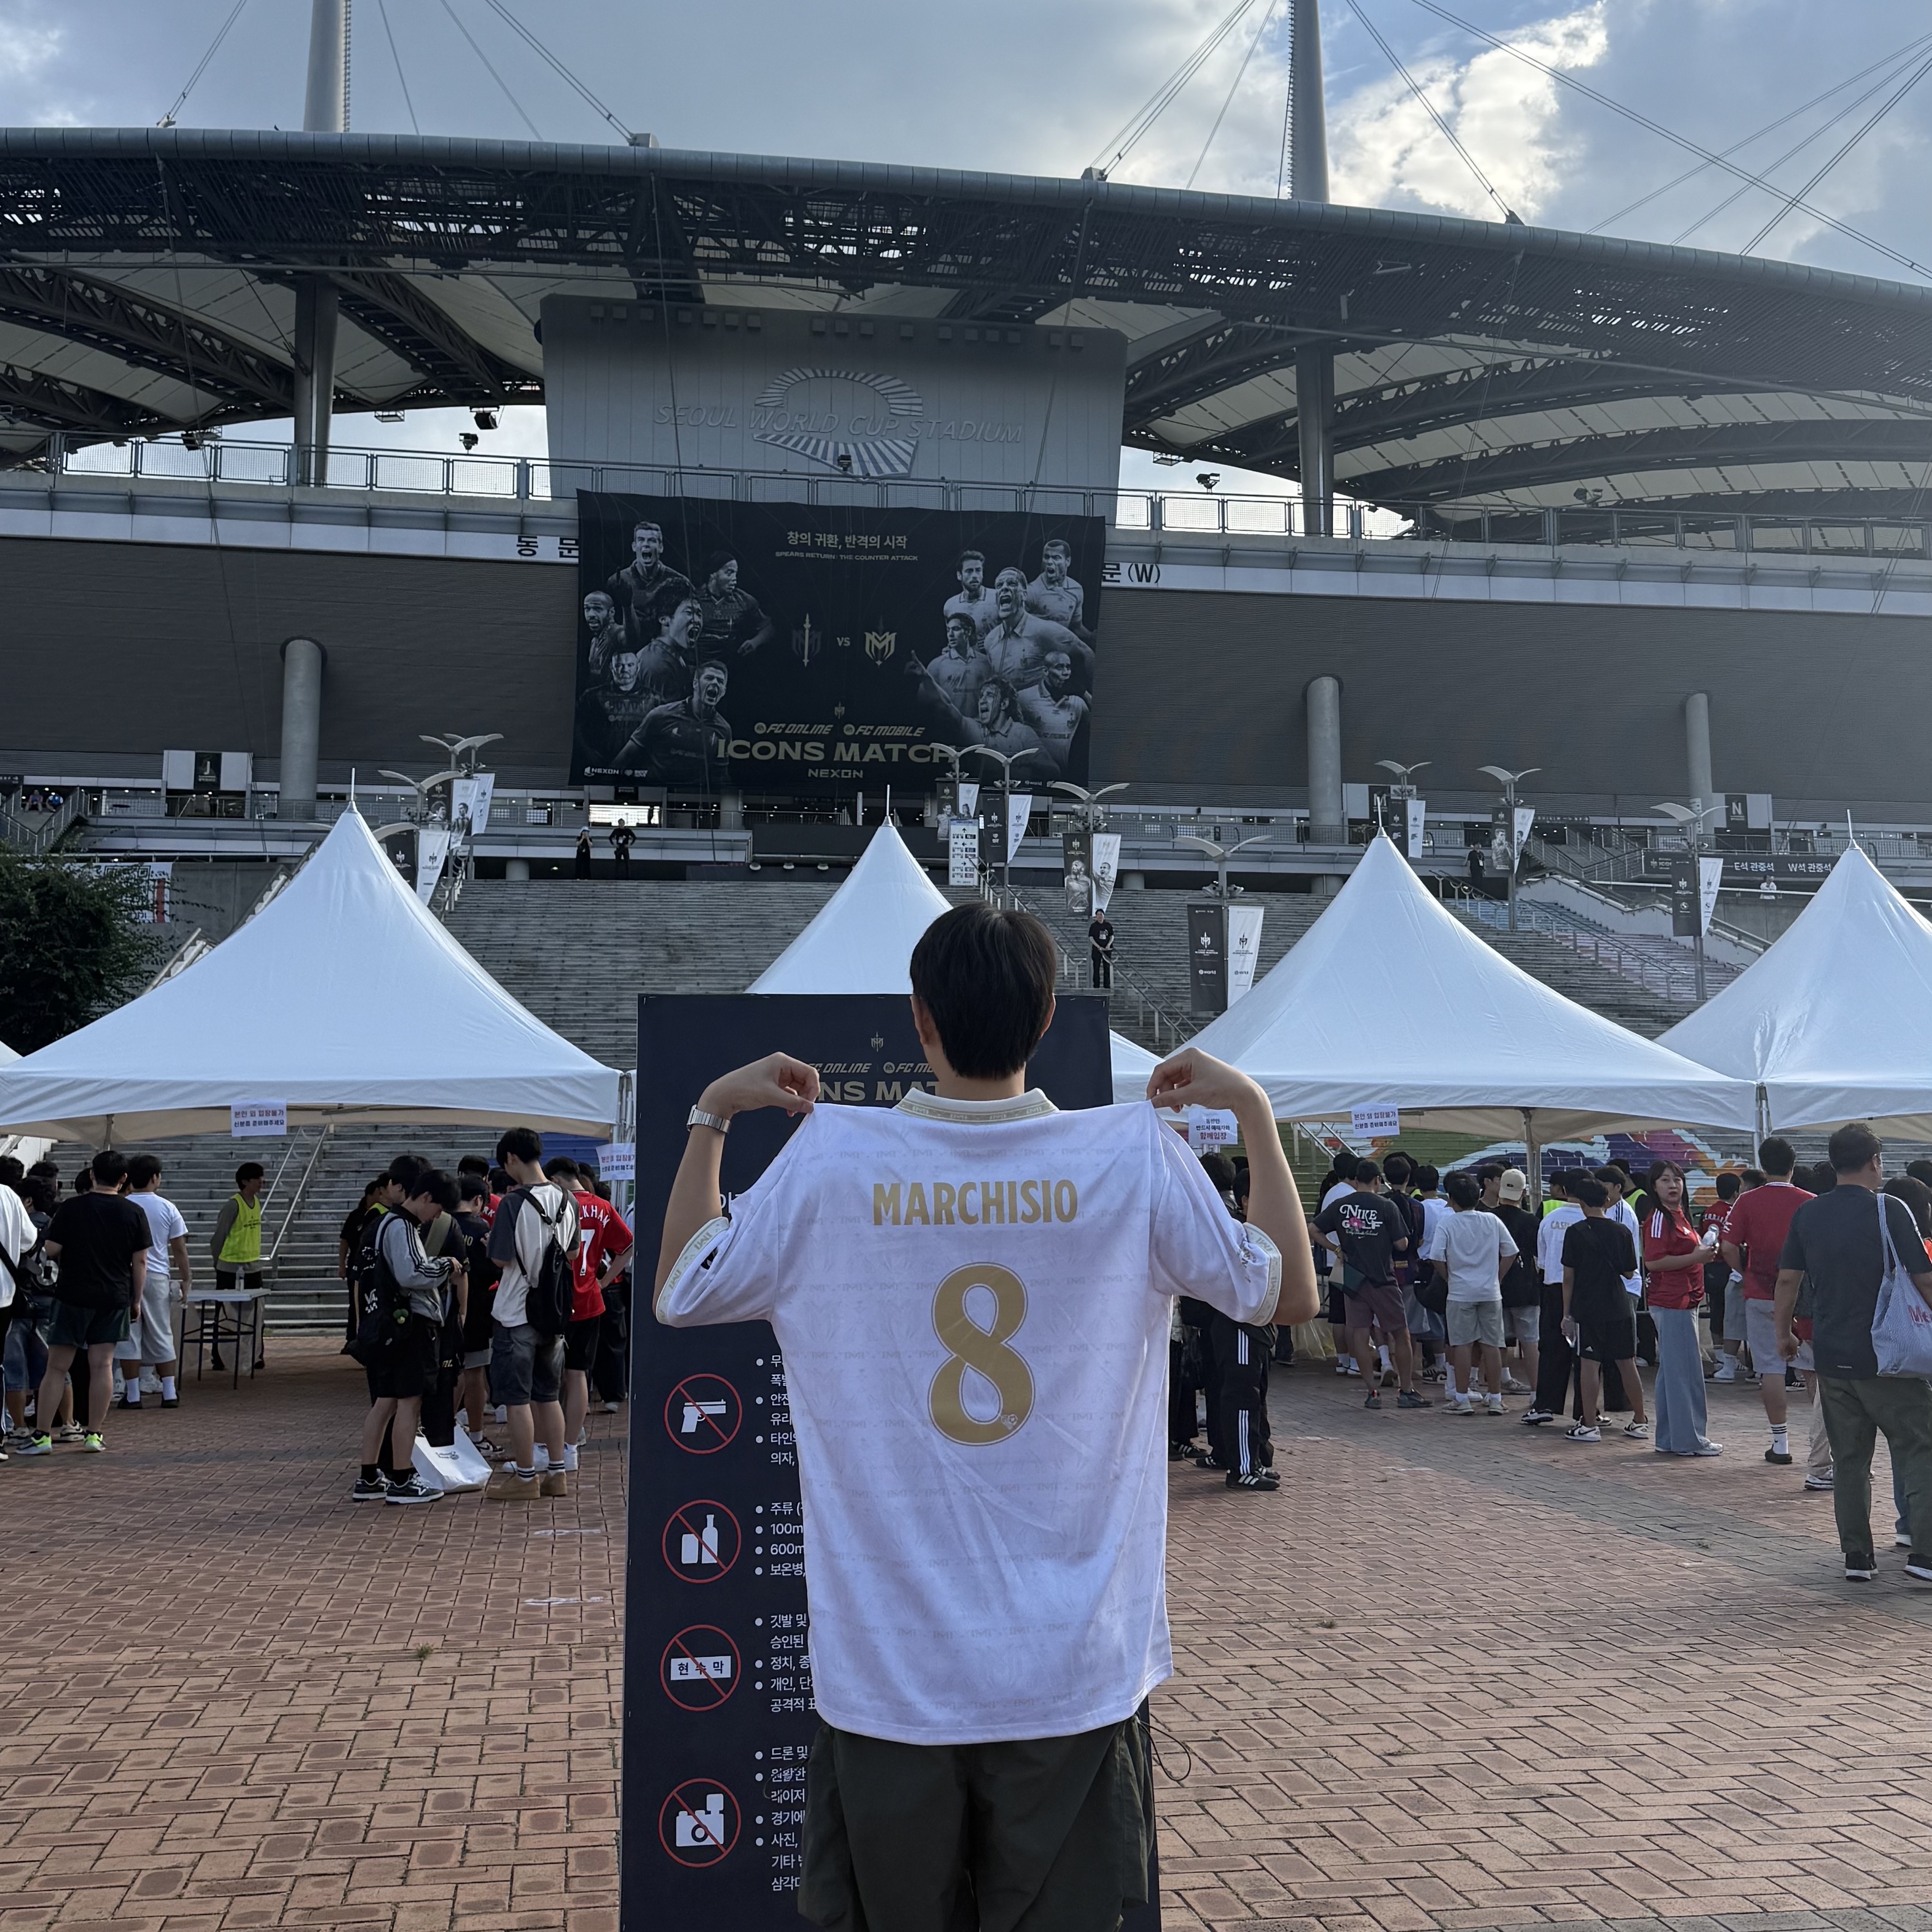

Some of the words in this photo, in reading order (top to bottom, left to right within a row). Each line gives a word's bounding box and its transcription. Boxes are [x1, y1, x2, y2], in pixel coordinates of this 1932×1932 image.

[653, 405, 736, 428] SEOUL
[749, 408, 840, 433] WORLD
[848, 415, 900, 437] CUP
[906, 419, 1023, 443] STADIUM
[787, 531, 811, 546] 창의
[814, 532, 842, 550] 귀환,
[845, 534, 880, 549] 반격의
[883, 535, 907, 549] 시작
[717, 739, 825, 761] ICONS
[808, 768, 863, 779] NEXON
[1732, 802, 1742, 815] N
[1734, 861, 1748, 871] E석
[1750, 862, 1774, 872] 관중석
[1788, 863, 1806, 872] W석
[1808, 863, 1831, 872] 관중석
[823, 1063, 872, 1073] ONLINE
[895, 1063, 914, 1073] FC
[873, 1179, 1078, 1226] MARCHISIO
[1340, 1204, 1378, 1225] NIKE
[580, 1229, 595, 1276] 7
[770, 1355, 783, 1367] 무
[928, 1262, 1035, 1446] 8
[770, 1451, 795, 1466] 의자,
[770, 1502, 793, 1515] 주류
[770, 1562, 805, 1577] 보온병,
[770, 1614, 793, 1628] 깃발
[797, 1613, 807, 1627] 및
[770, 1634, 804, 1649] 승인된
[770, 1656, 795, 1671] 정치,
[770, 1677, 795, 1692] 개인,
[800, 1676, 813, 1689] 단
[770, 1698, 804, 1712] 공격적
[771, 1746, 794, 1760] 드론
[797, 1745, 807, 1759] 및
[771, 1810, 805, 1825] 경기에
[771, 1832, 798, 1848] 사진,
[771, 1854, 796, 1869] 기타
